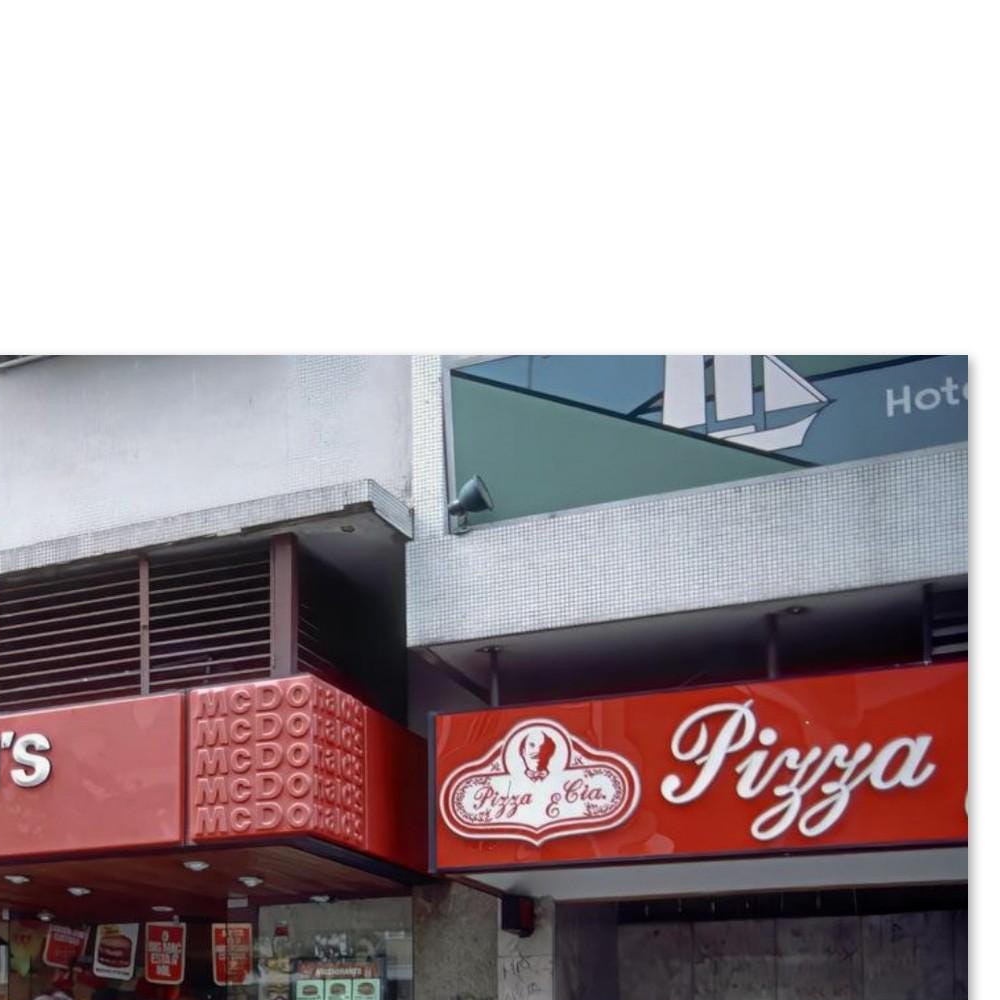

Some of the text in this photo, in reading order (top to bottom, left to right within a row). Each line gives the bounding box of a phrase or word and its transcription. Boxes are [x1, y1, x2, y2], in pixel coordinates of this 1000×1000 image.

[885, 376, 968, 416] Hot
[661, 699, 936, 840] Pizza
[473, 785, 533, 818] Pizza
[563, 778, 606, 804] Cia.
